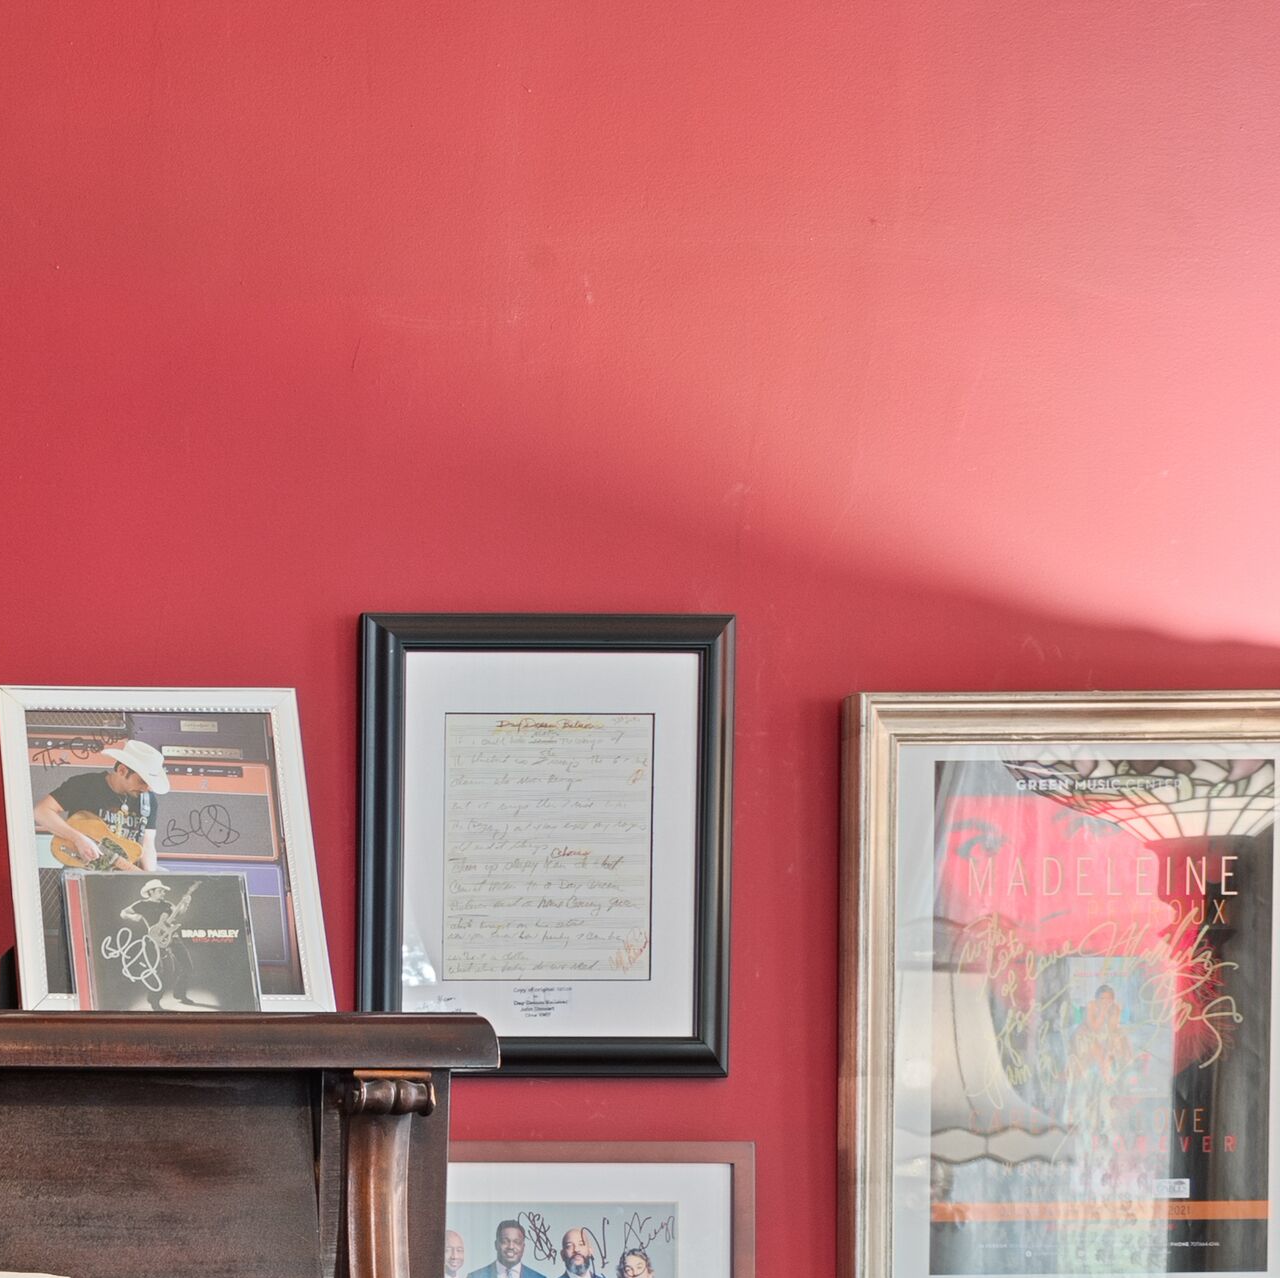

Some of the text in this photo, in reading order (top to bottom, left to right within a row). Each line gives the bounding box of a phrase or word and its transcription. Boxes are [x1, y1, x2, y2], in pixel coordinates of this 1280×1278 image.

[1016, 780, 1182, 790] GREEN MUSIC CENTER
[968, 856, 1239, 896] MADELEINE
[181, 928, 240, 938] BRAD PAISLEY
